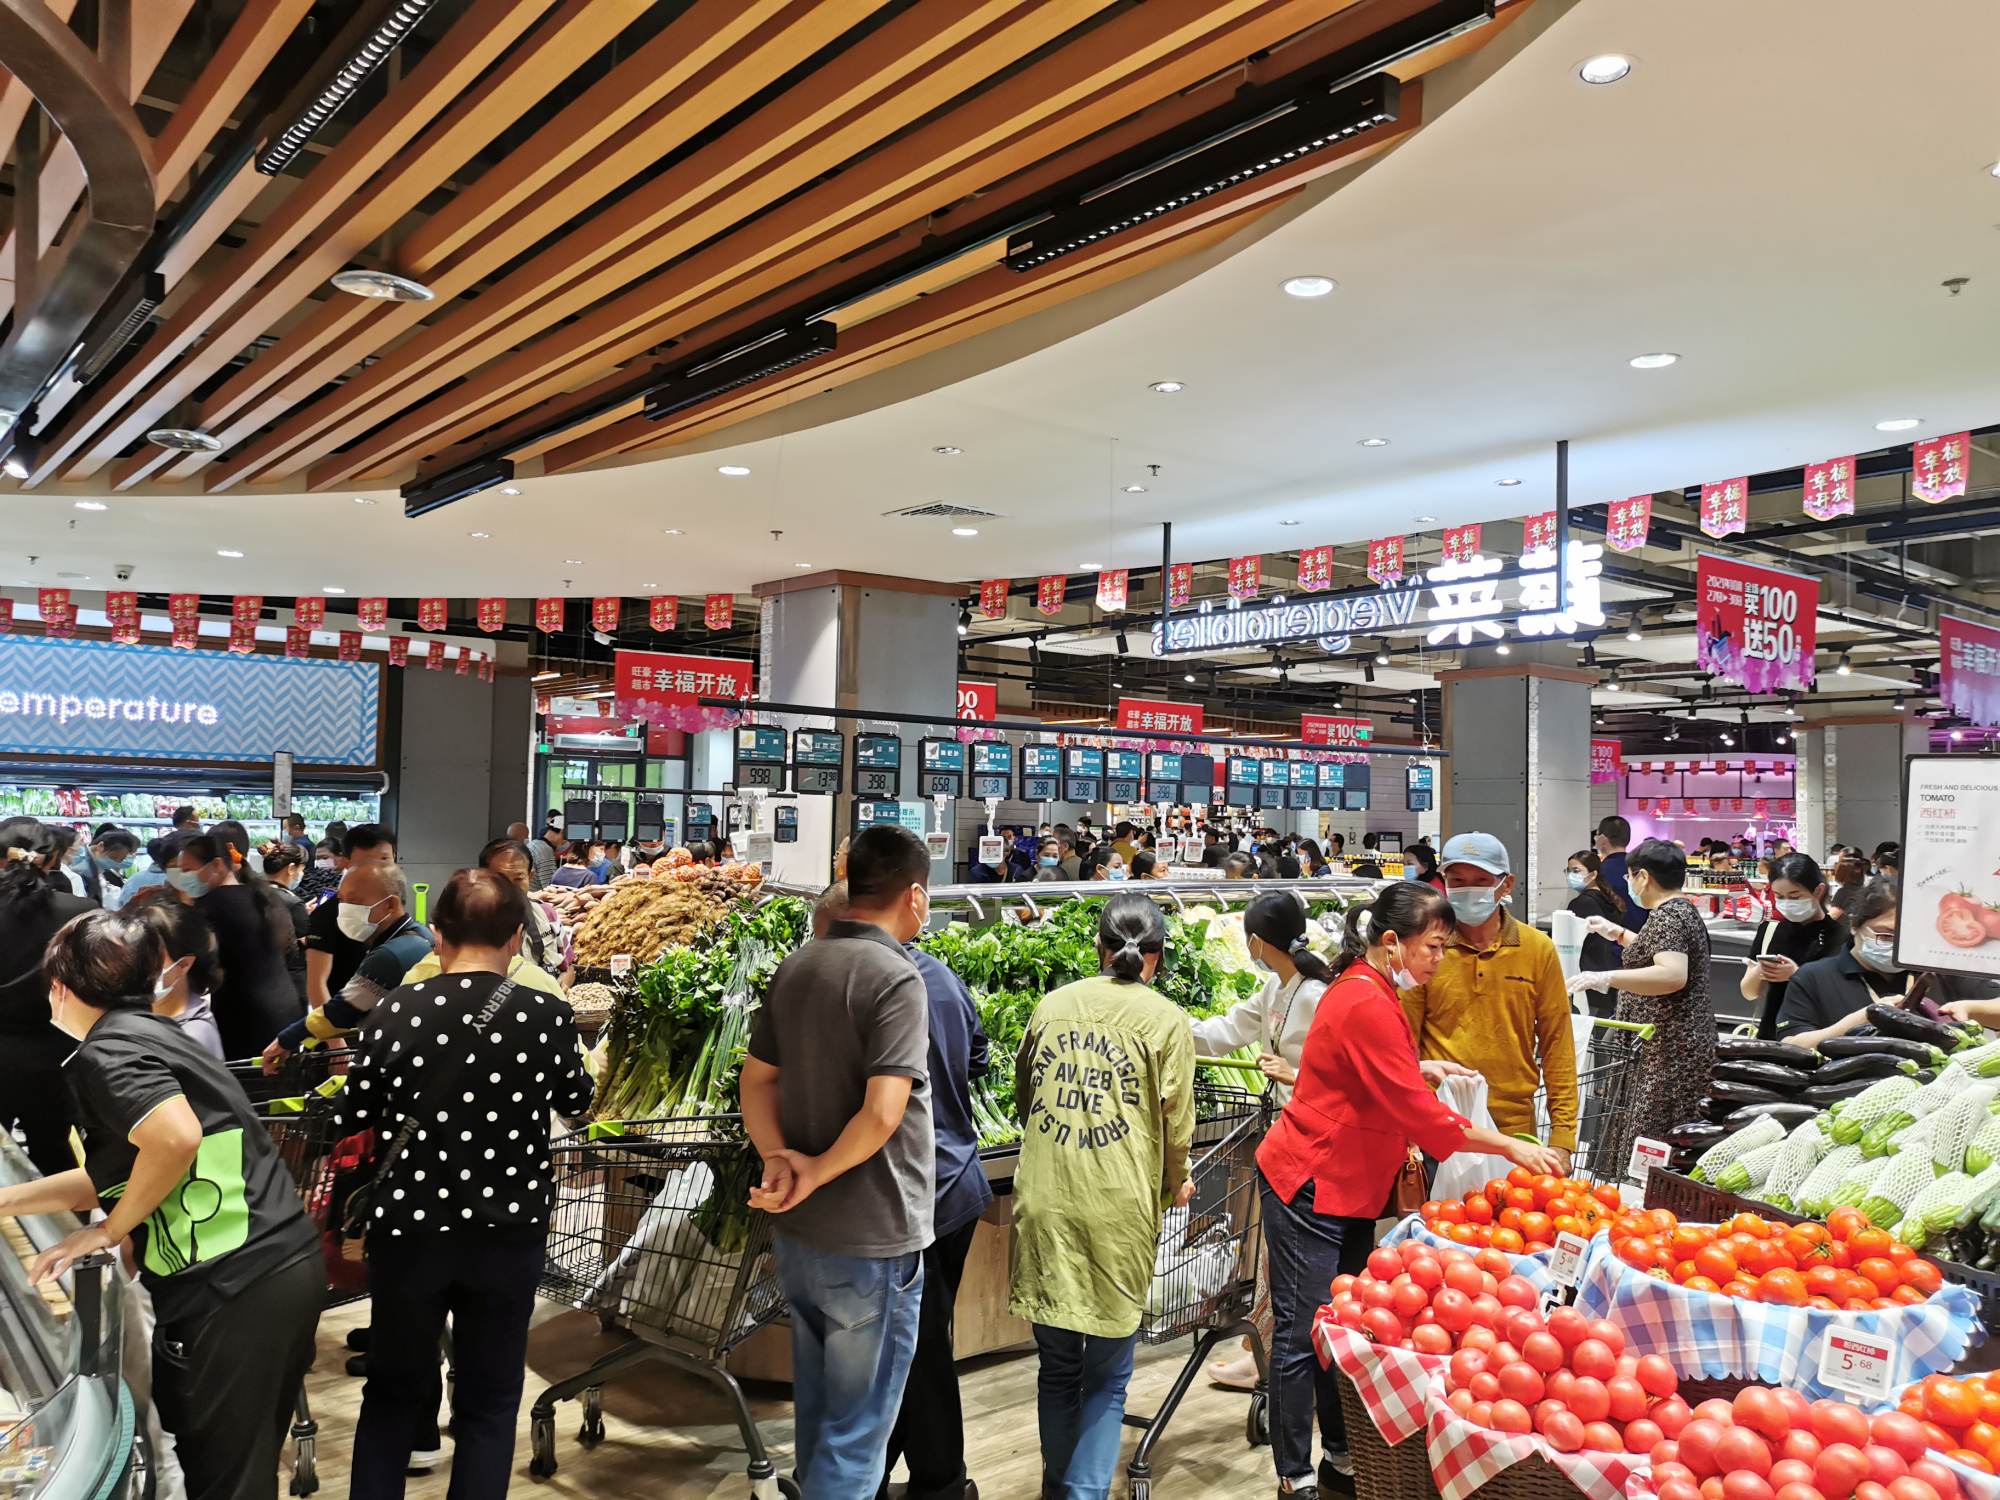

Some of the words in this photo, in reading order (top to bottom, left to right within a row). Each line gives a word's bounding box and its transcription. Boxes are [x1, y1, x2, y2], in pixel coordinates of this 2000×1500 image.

[1919, 440, 1962, 471] 幸福
[1809, 461, 1848, 490] 幸福
[1923, 463, 1964, 493] 开放
[1707, 483, 1740, 510] 幸福
[1812, 483, 1849, 511] 开放
[1615, 501, 1644, 525] 幸福
[1710, 503, 1741, 529] 开放
[1447, 529, 1476, 550] 幸福
[1615, 519, 1644, 543] 开放
[1303, 550, 1328, 570] 幸福
[1373, 540, 1399, 561] 幸福
[1233, 559, 1257, 579] 幸福
[1304, 565, 1329, 584] 开放
[1374, 556, 1400, 577] 开放
[986, 583, 1004, 600] 幸福
[1042, 578, 1062, 595] 幸福
[1102, 574, 1124, 591] 幸福
[1234, 573, 1257, 592] 开放
[985, 596, 1004, 610] 开放
[1043, 593, 1062, 608] 开放
[1102, 588, 1124, 603] 开放
[631, 666, 652, 678] 旺豪
[631, 679, 652, 691] 超市
[653, 669, 737, 697] 幸福开放
[0, 690, 219, 725] emperature
[1127, 710, 1141, 719] 旺豪
[1126, 720, 1139, 729] 超市
[1140, 712, 1193, 733] 幸福开放
[1920, 794, 1955, 803] TOMATO
[1920, 808, 1956, 819] 西红柿
[1032, 1045, 1057, 1088] SAN
[1056, 1030, 1140, 1106] FRANCISCO
[1056, 1087, 1104, 1115] LOVE
[1079, 1113, 1130, 1150] FROM
